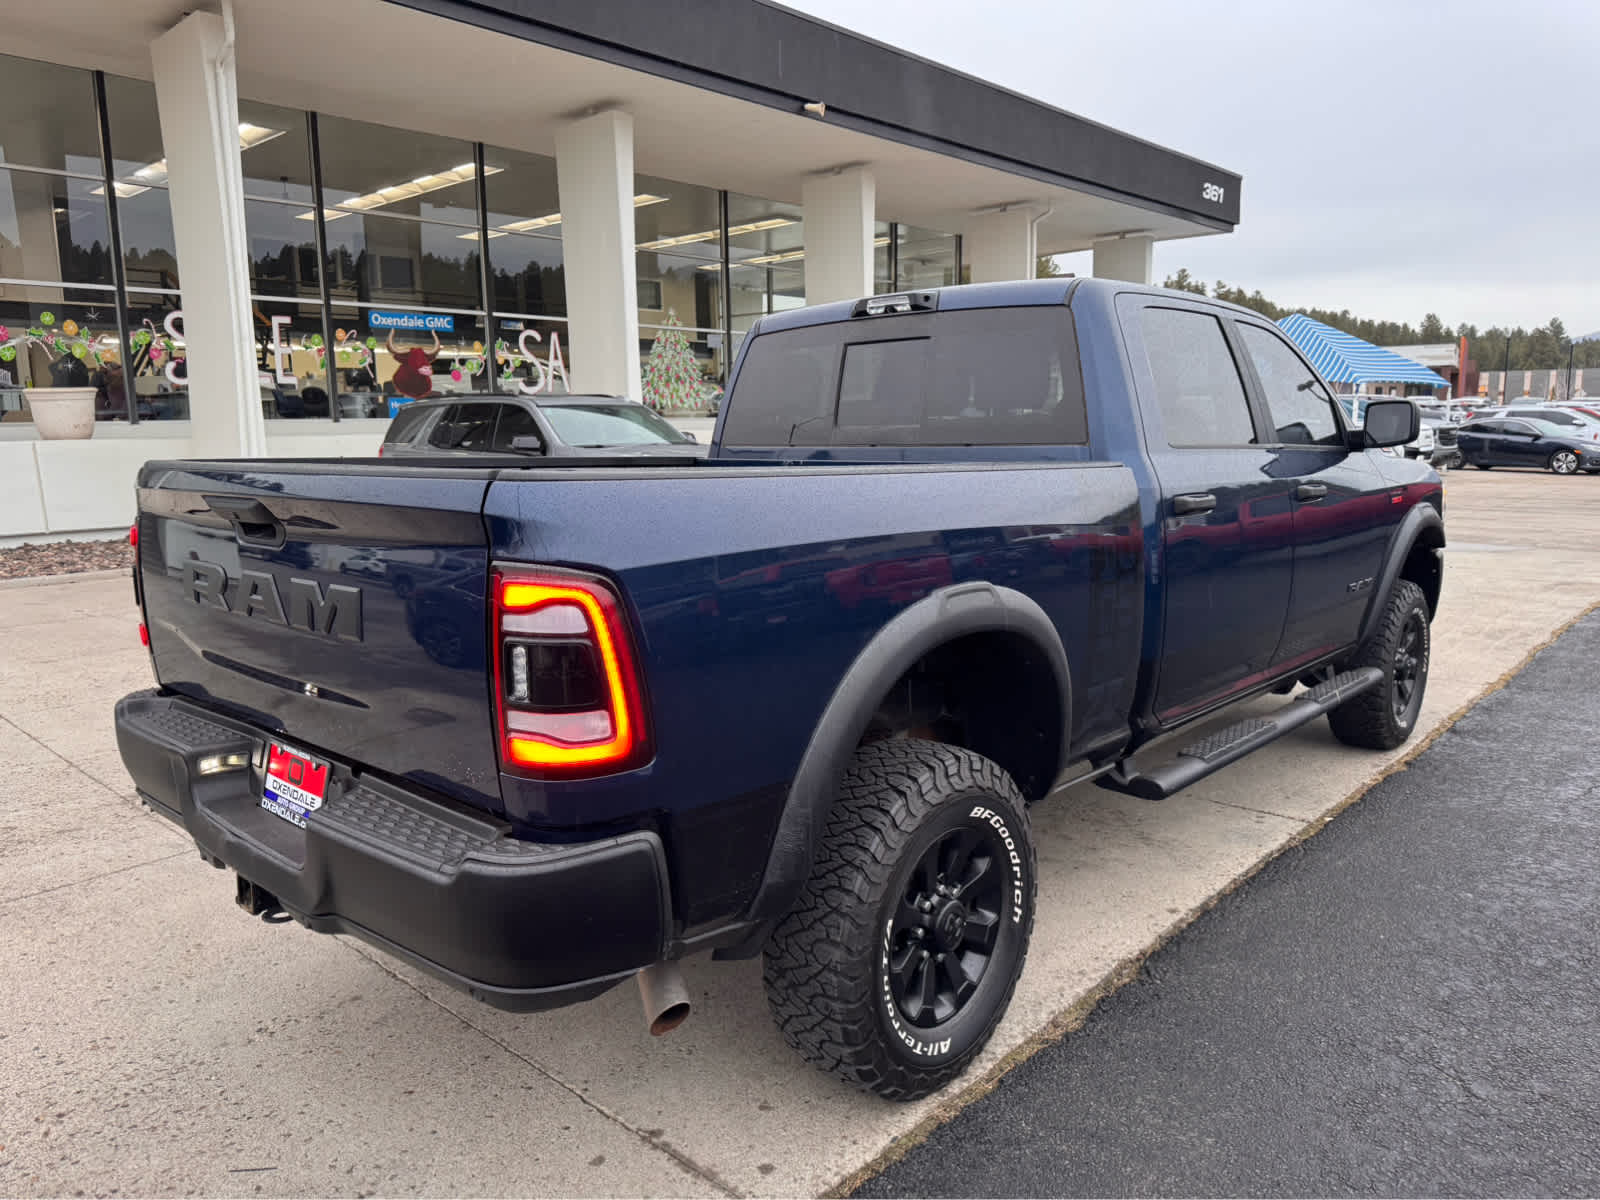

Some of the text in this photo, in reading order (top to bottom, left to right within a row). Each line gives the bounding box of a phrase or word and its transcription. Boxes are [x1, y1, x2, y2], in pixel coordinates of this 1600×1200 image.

[1202, 182, 1224, 203] 361
[371, 313, 452, 329] Oxendale GMC
[184, 559, 364, 642] RAM
[272, 779, 317, 809] OXENDALE
[969, 806, 1023, 923] BFGoodrich
[883, 975, 951, 1056] All-Terrain
